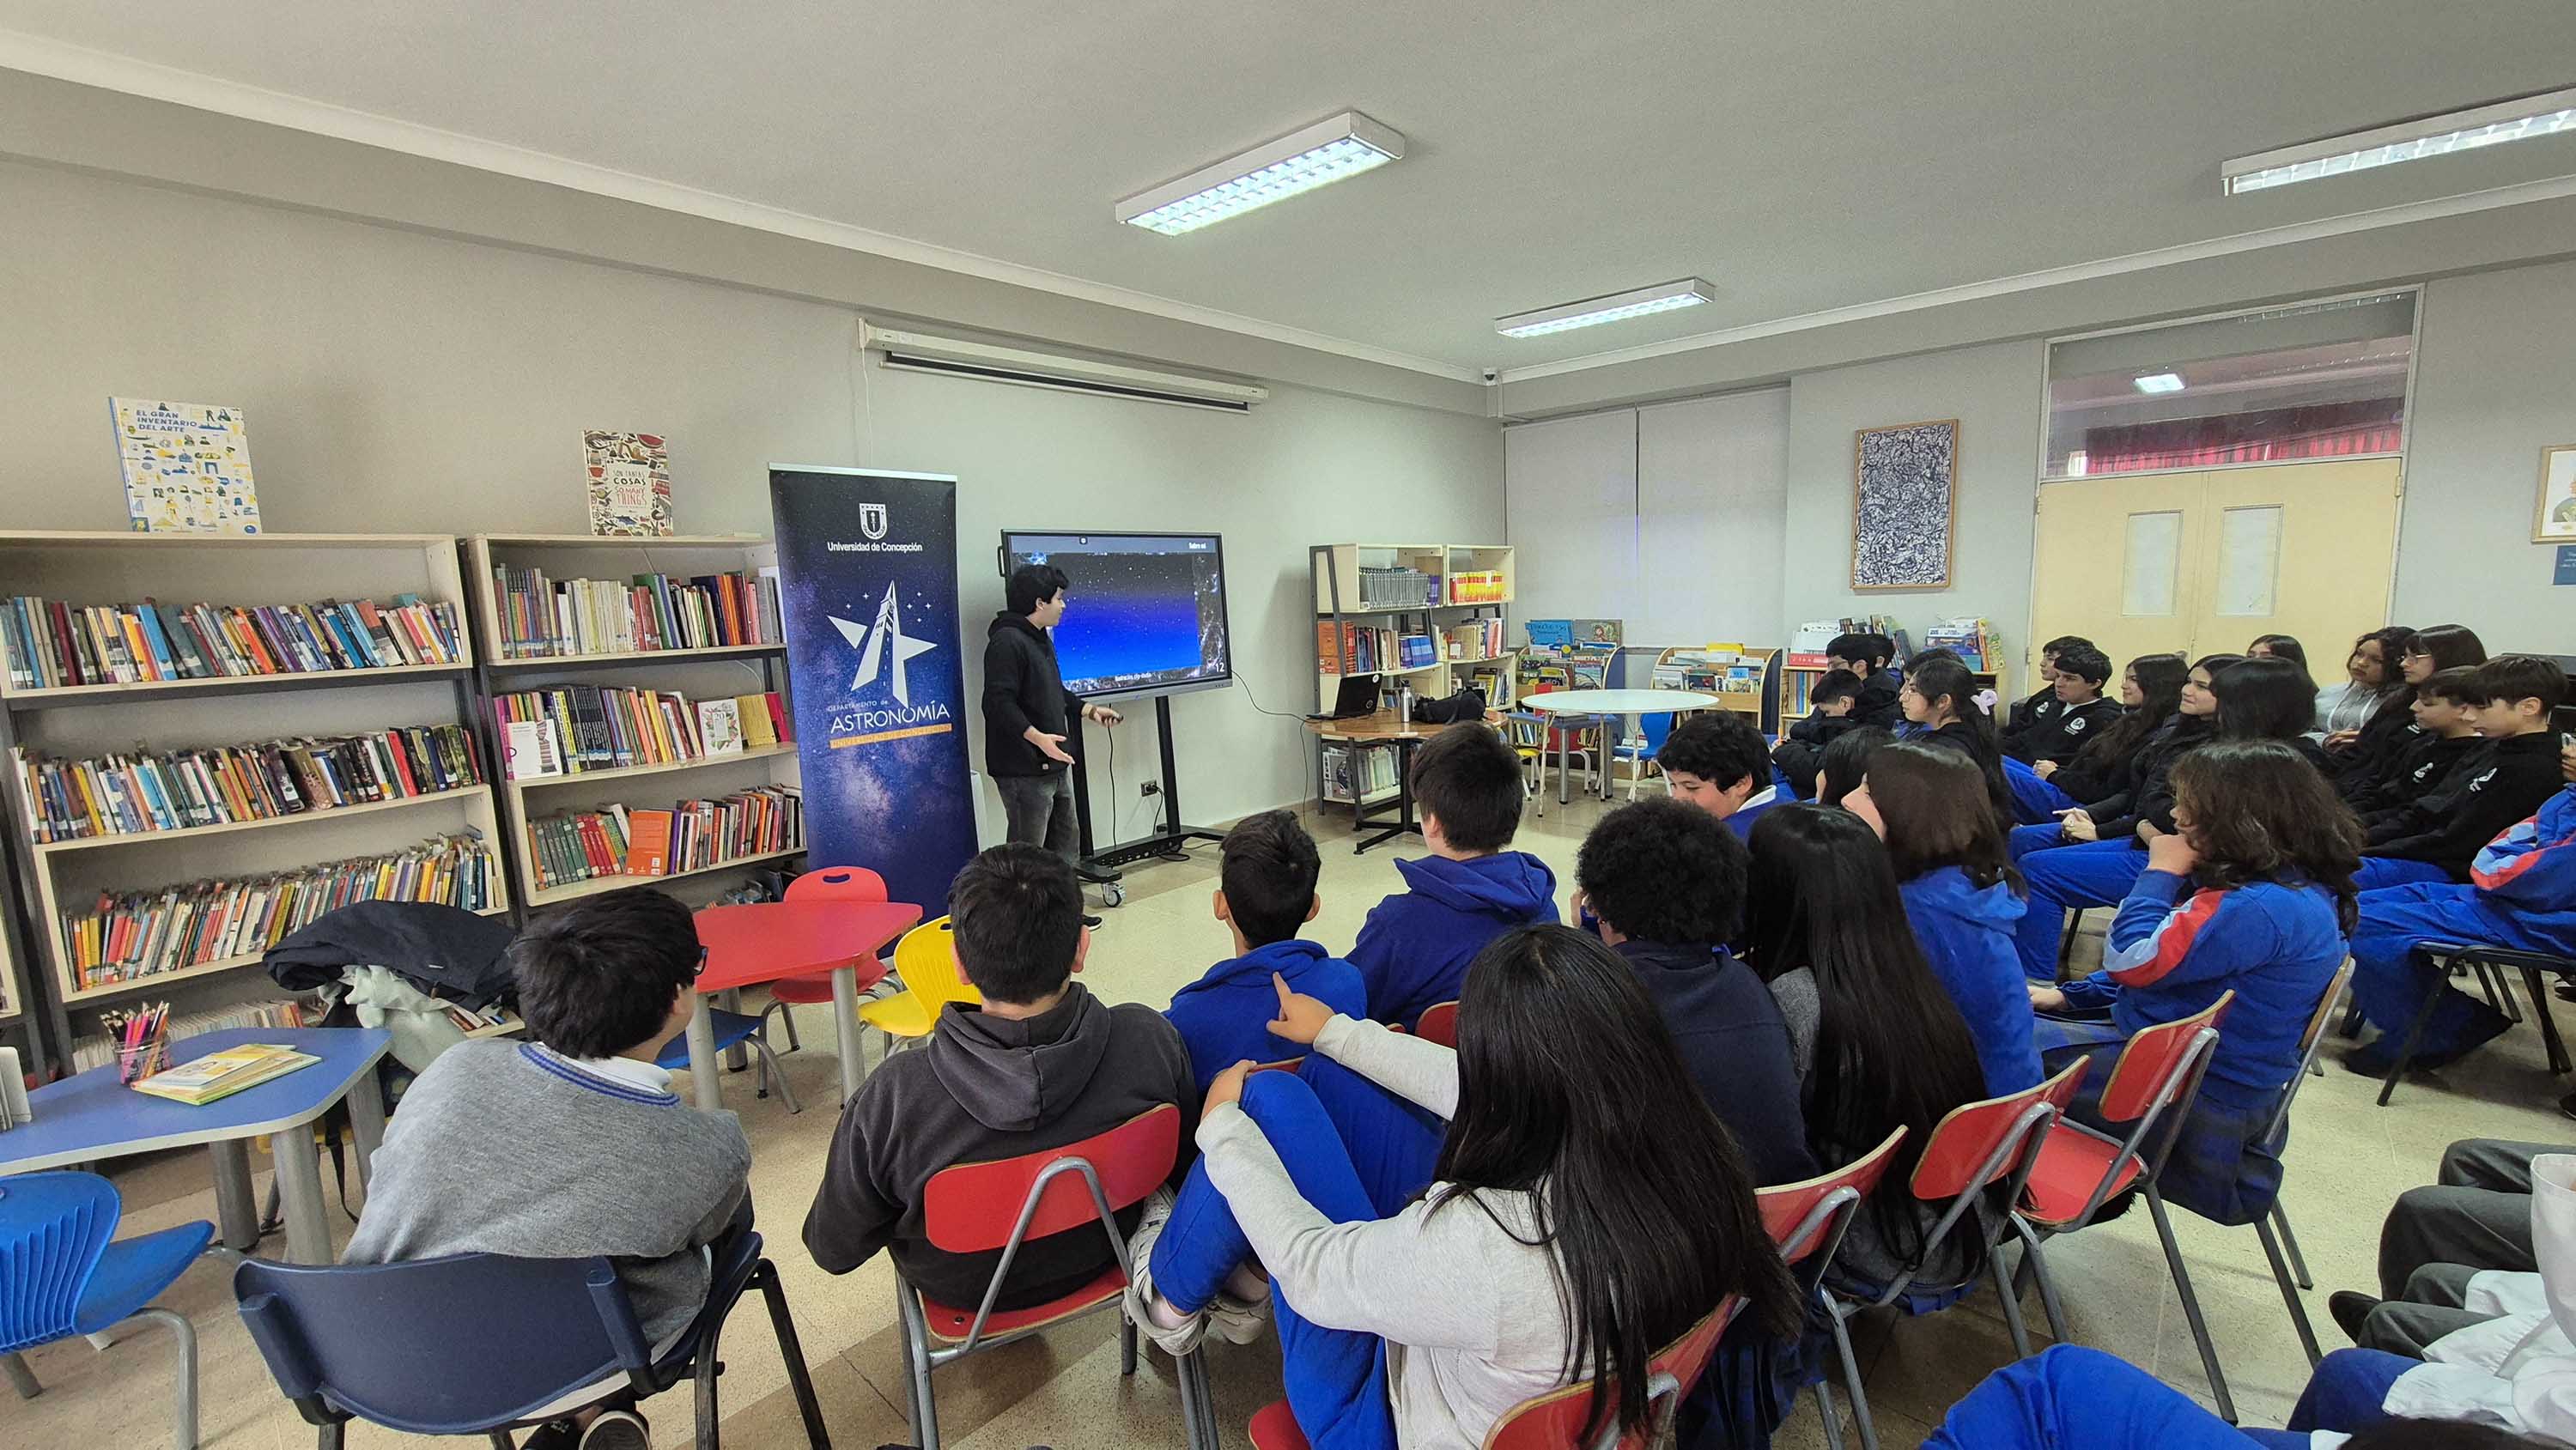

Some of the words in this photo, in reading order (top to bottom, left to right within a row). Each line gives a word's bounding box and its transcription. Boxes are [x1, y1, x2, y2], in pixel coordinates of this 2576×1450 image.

[137, 417, 197, 427] INVENTARIO
[613, 476, 647, 486] COSAS
[617, 493, 647, 506] THINGS
[827, 541, 871, 551] Universidad
[871, 542, 881, 551] de
[881, 541, 923, 554] Concepción
[1216, 662, 1224, 673] 12
[828, 700, 878, 712] DEPARTAMENTO
[830, 700, 951, 734] ASTRONOMÍA
